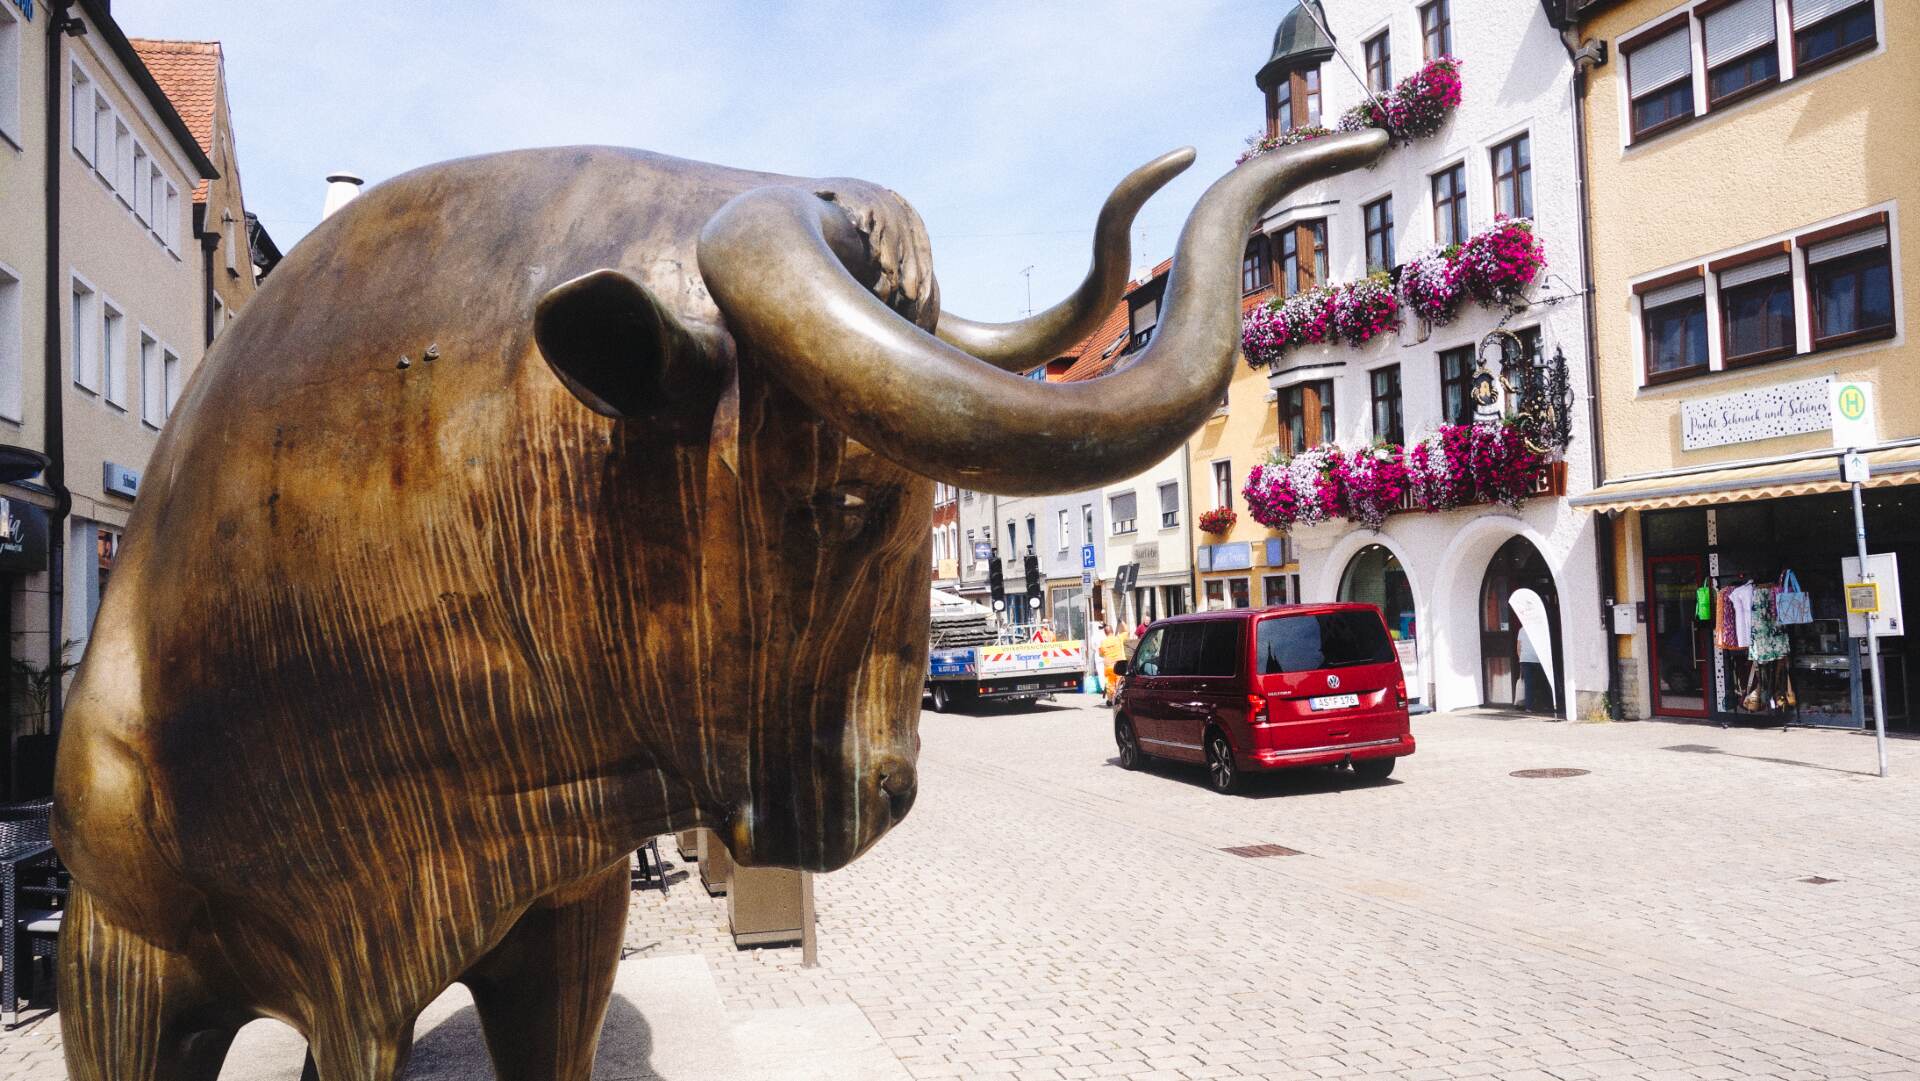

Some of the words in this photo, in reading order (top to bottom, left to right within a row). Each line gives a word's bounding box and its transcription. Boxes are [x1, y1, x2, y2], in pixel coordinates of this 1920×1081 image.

[1721, 409, 1761, 428] Schmuck
[1764, 404, 1784, 419] und
[1084, 548, 1092, 566] P
